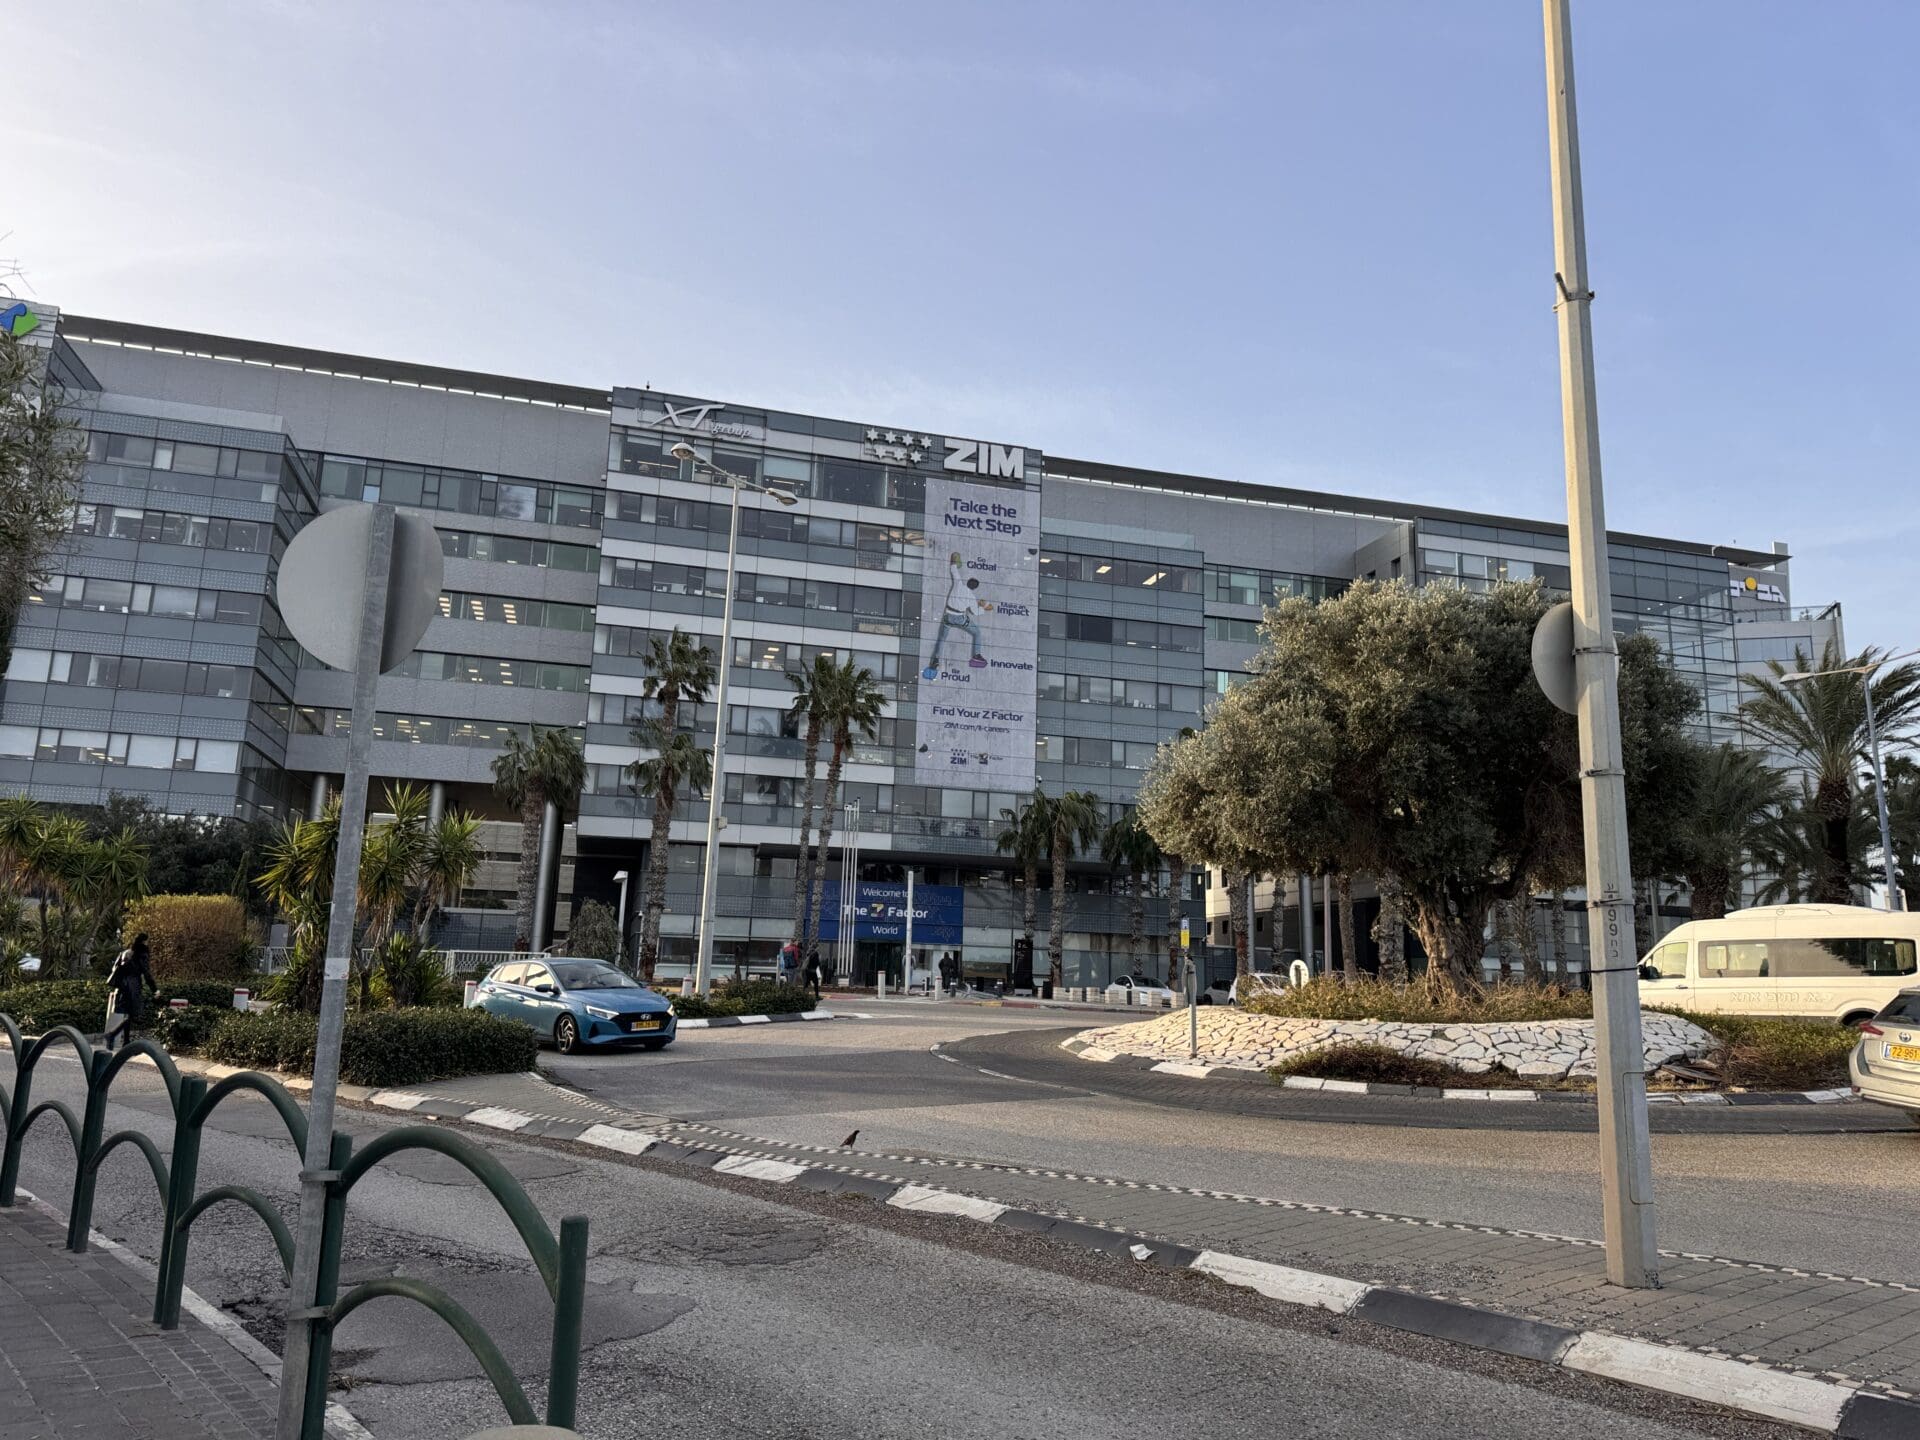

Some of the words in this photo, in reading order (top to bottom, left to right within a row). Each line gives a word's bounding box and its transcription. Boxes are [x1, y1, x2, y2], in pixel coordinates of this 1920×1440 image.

[650, 402, 726, 429] XT
[711, 423, 752, 439] group
[943, 439, 1025, 480] ZIM
[949, 497, 989, 516] Take
[991, 503, 1017, 518] the
[944, 514, 983, 531] Next
[985, 519, 1022, 537] Step
[966, 560, 997, 572] Global
[997, 605, 1030, 617] Impact
[991, 659, 1033, 671] Innovate
[941, 671, 971, 682] Proud
[932, 706, 956, 717] Find
[958, 708, 981, 719] Your
[982, 710, 990, 720] Z
[991, 711, 1024, 722] Factor
[950, 757, 967, 765] ZIM
[862, 887, 902, 897] Welcome
[873, 925, 898, 935] World
[1729, 991, 1761, 1003] אתא
